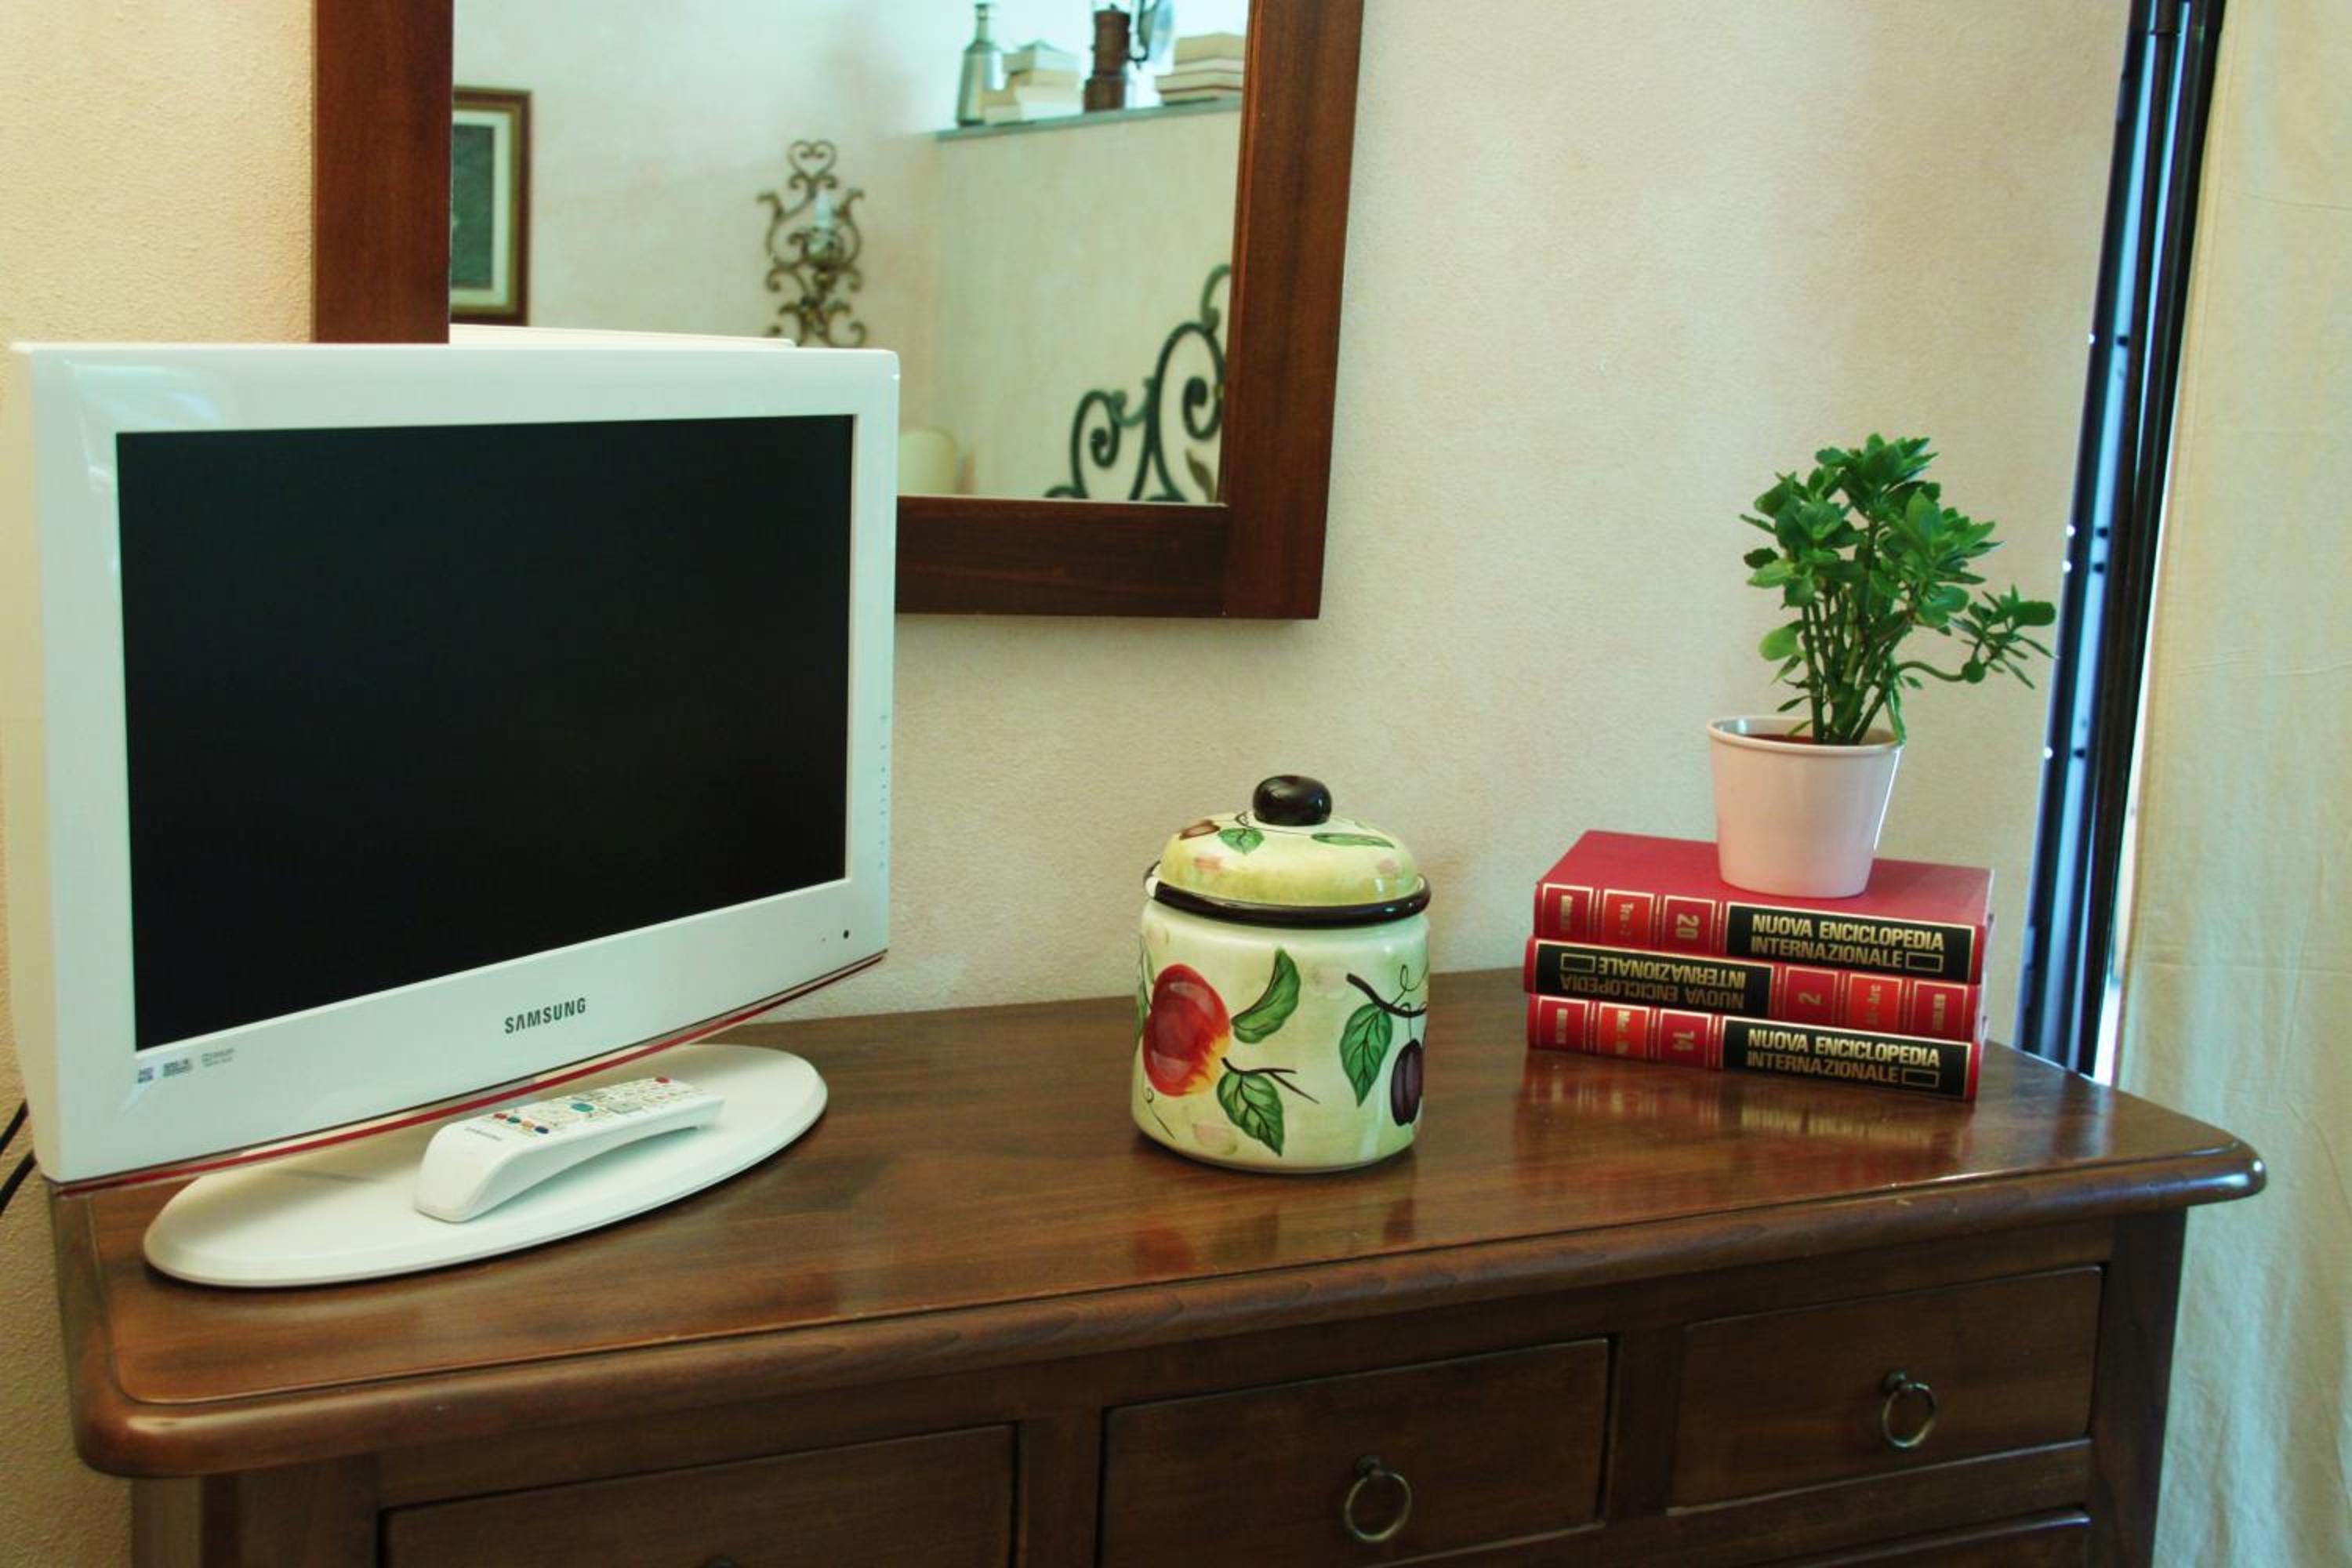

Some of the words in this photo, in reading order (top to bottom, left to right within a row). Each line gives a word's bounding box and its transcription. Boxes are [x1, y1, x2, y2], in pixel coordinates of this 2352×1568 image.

[1675, 913, 1700, 939] 20
[1752, 914, 1813, 938] NUOVA
[1819, 921, 1944, 952] ENCICLOPEDIA
[1751, 936, 1903, 968] INTERNAZIONALE
[1560, 973, 1679, 1003] ENCICLOPEDIA
[1599, 956, 1746, 989] INTERNAZIONALE
[1686, 985, 1744, 1009] NUOVA
[1798, 992, 1821, 1005] 2
[504, 997, 586, 1034] SAMSUNG
[1672, 1030, 1696, 1051] 14
[1748, 1029, 1809, 1053] NUOVA
[1815, 1036, 1940, 1067] ENCICLOPEDIA
[1747, 1051, 1900, 1083] INTERNAZIONALE
